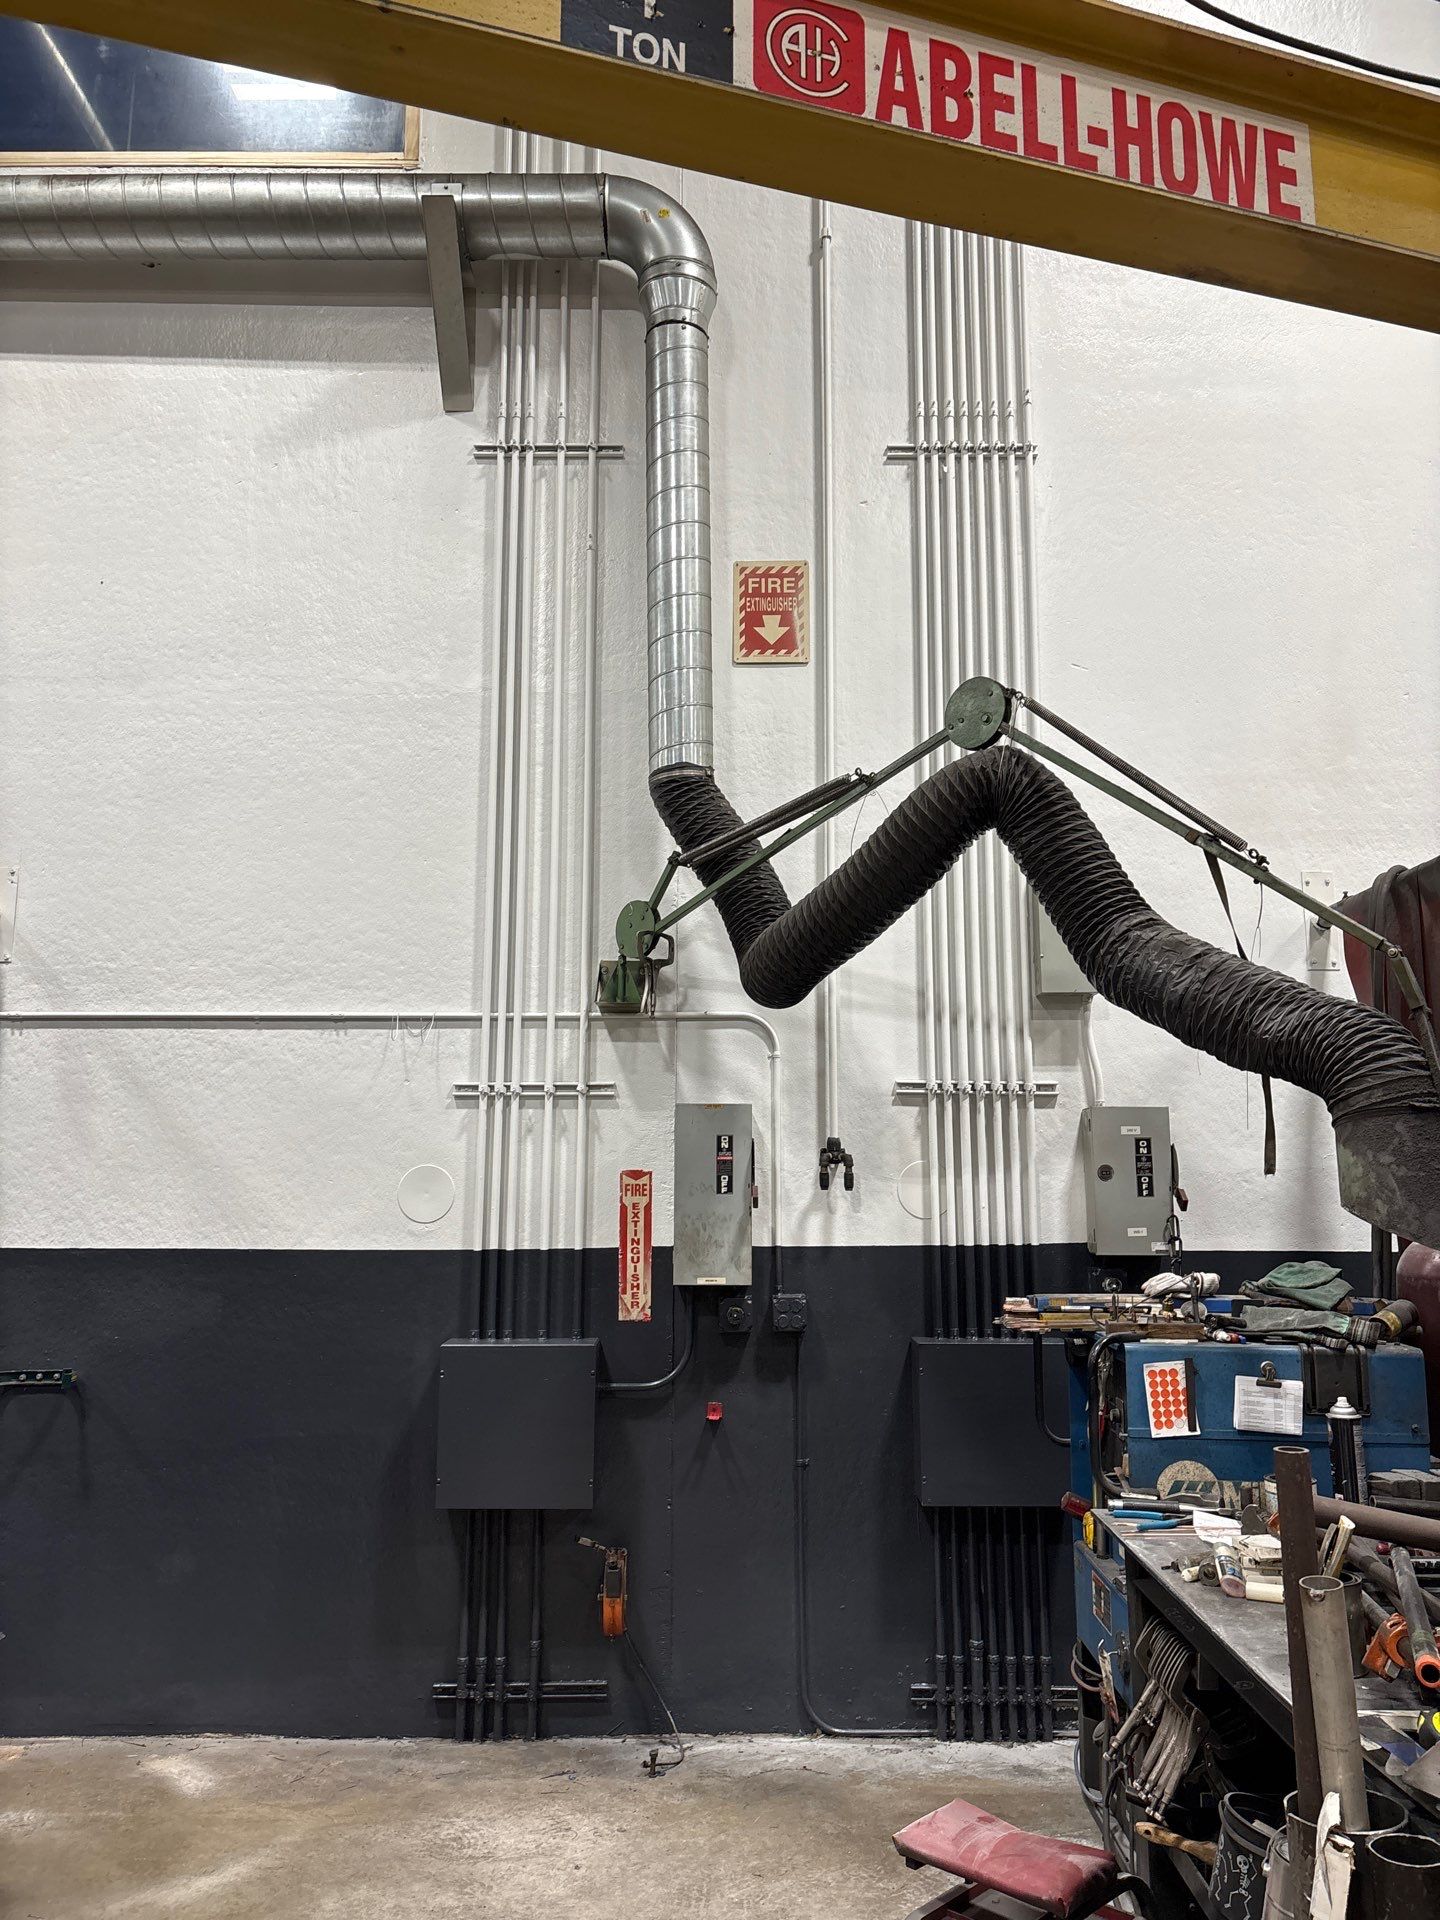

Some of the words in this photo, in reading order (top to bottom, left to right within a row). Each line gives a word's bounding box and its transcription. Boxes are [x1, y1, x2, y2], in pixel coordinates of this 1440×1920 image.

[608, 24, 686, 73] TON
[875, 28, 1301, 221] ABELL-HOWE
[748, 577, 796, 593] FIRE
[746, 597, 798, 612] EXTINGUISHER
[720, 1135, 729, 1148] ON
[1139, 1140, 1147, 1154] ON
[624, 1183, 648, 1197] FIRE
[720, 1175, 729, 1194] OFF
[1141, 1176, 1149, 1197] OFF
[630, 1202, 641, 1309] EXTINGUISHER
